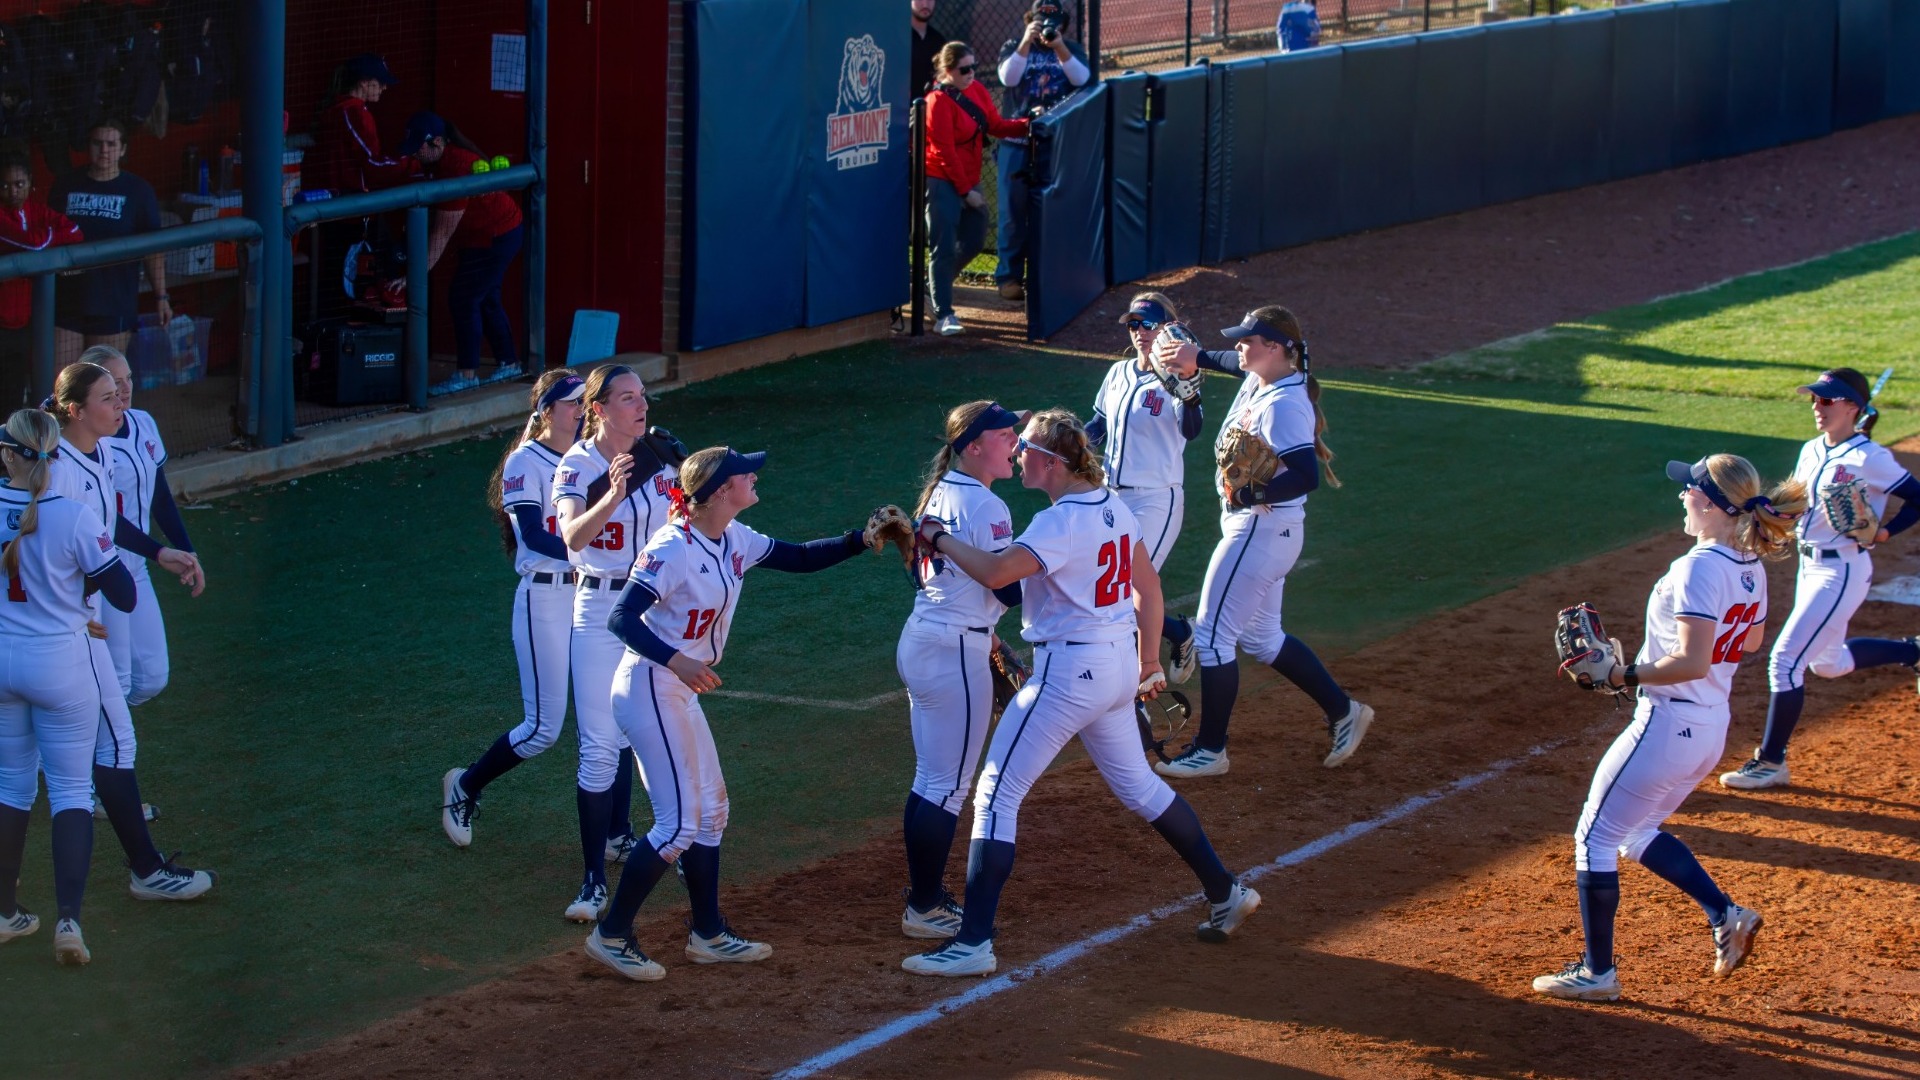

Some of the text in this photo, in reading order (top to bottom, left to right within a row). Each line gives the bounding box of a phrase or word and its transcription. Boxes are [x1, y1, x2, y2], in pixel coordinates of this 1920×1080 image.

[829, 108, 889, 152] BELMONT
[838, 151, 877, 168] BRUINS
[66, 192, 127, 213] BELMONT
[97, 210, 122, 220] FIELD
[1142, 389, 1164, 416] BU
[1095, 533, 1131, 608] 24
[683, 608, 716, 640] 12
[1711, 602, 1760, 664] 22
